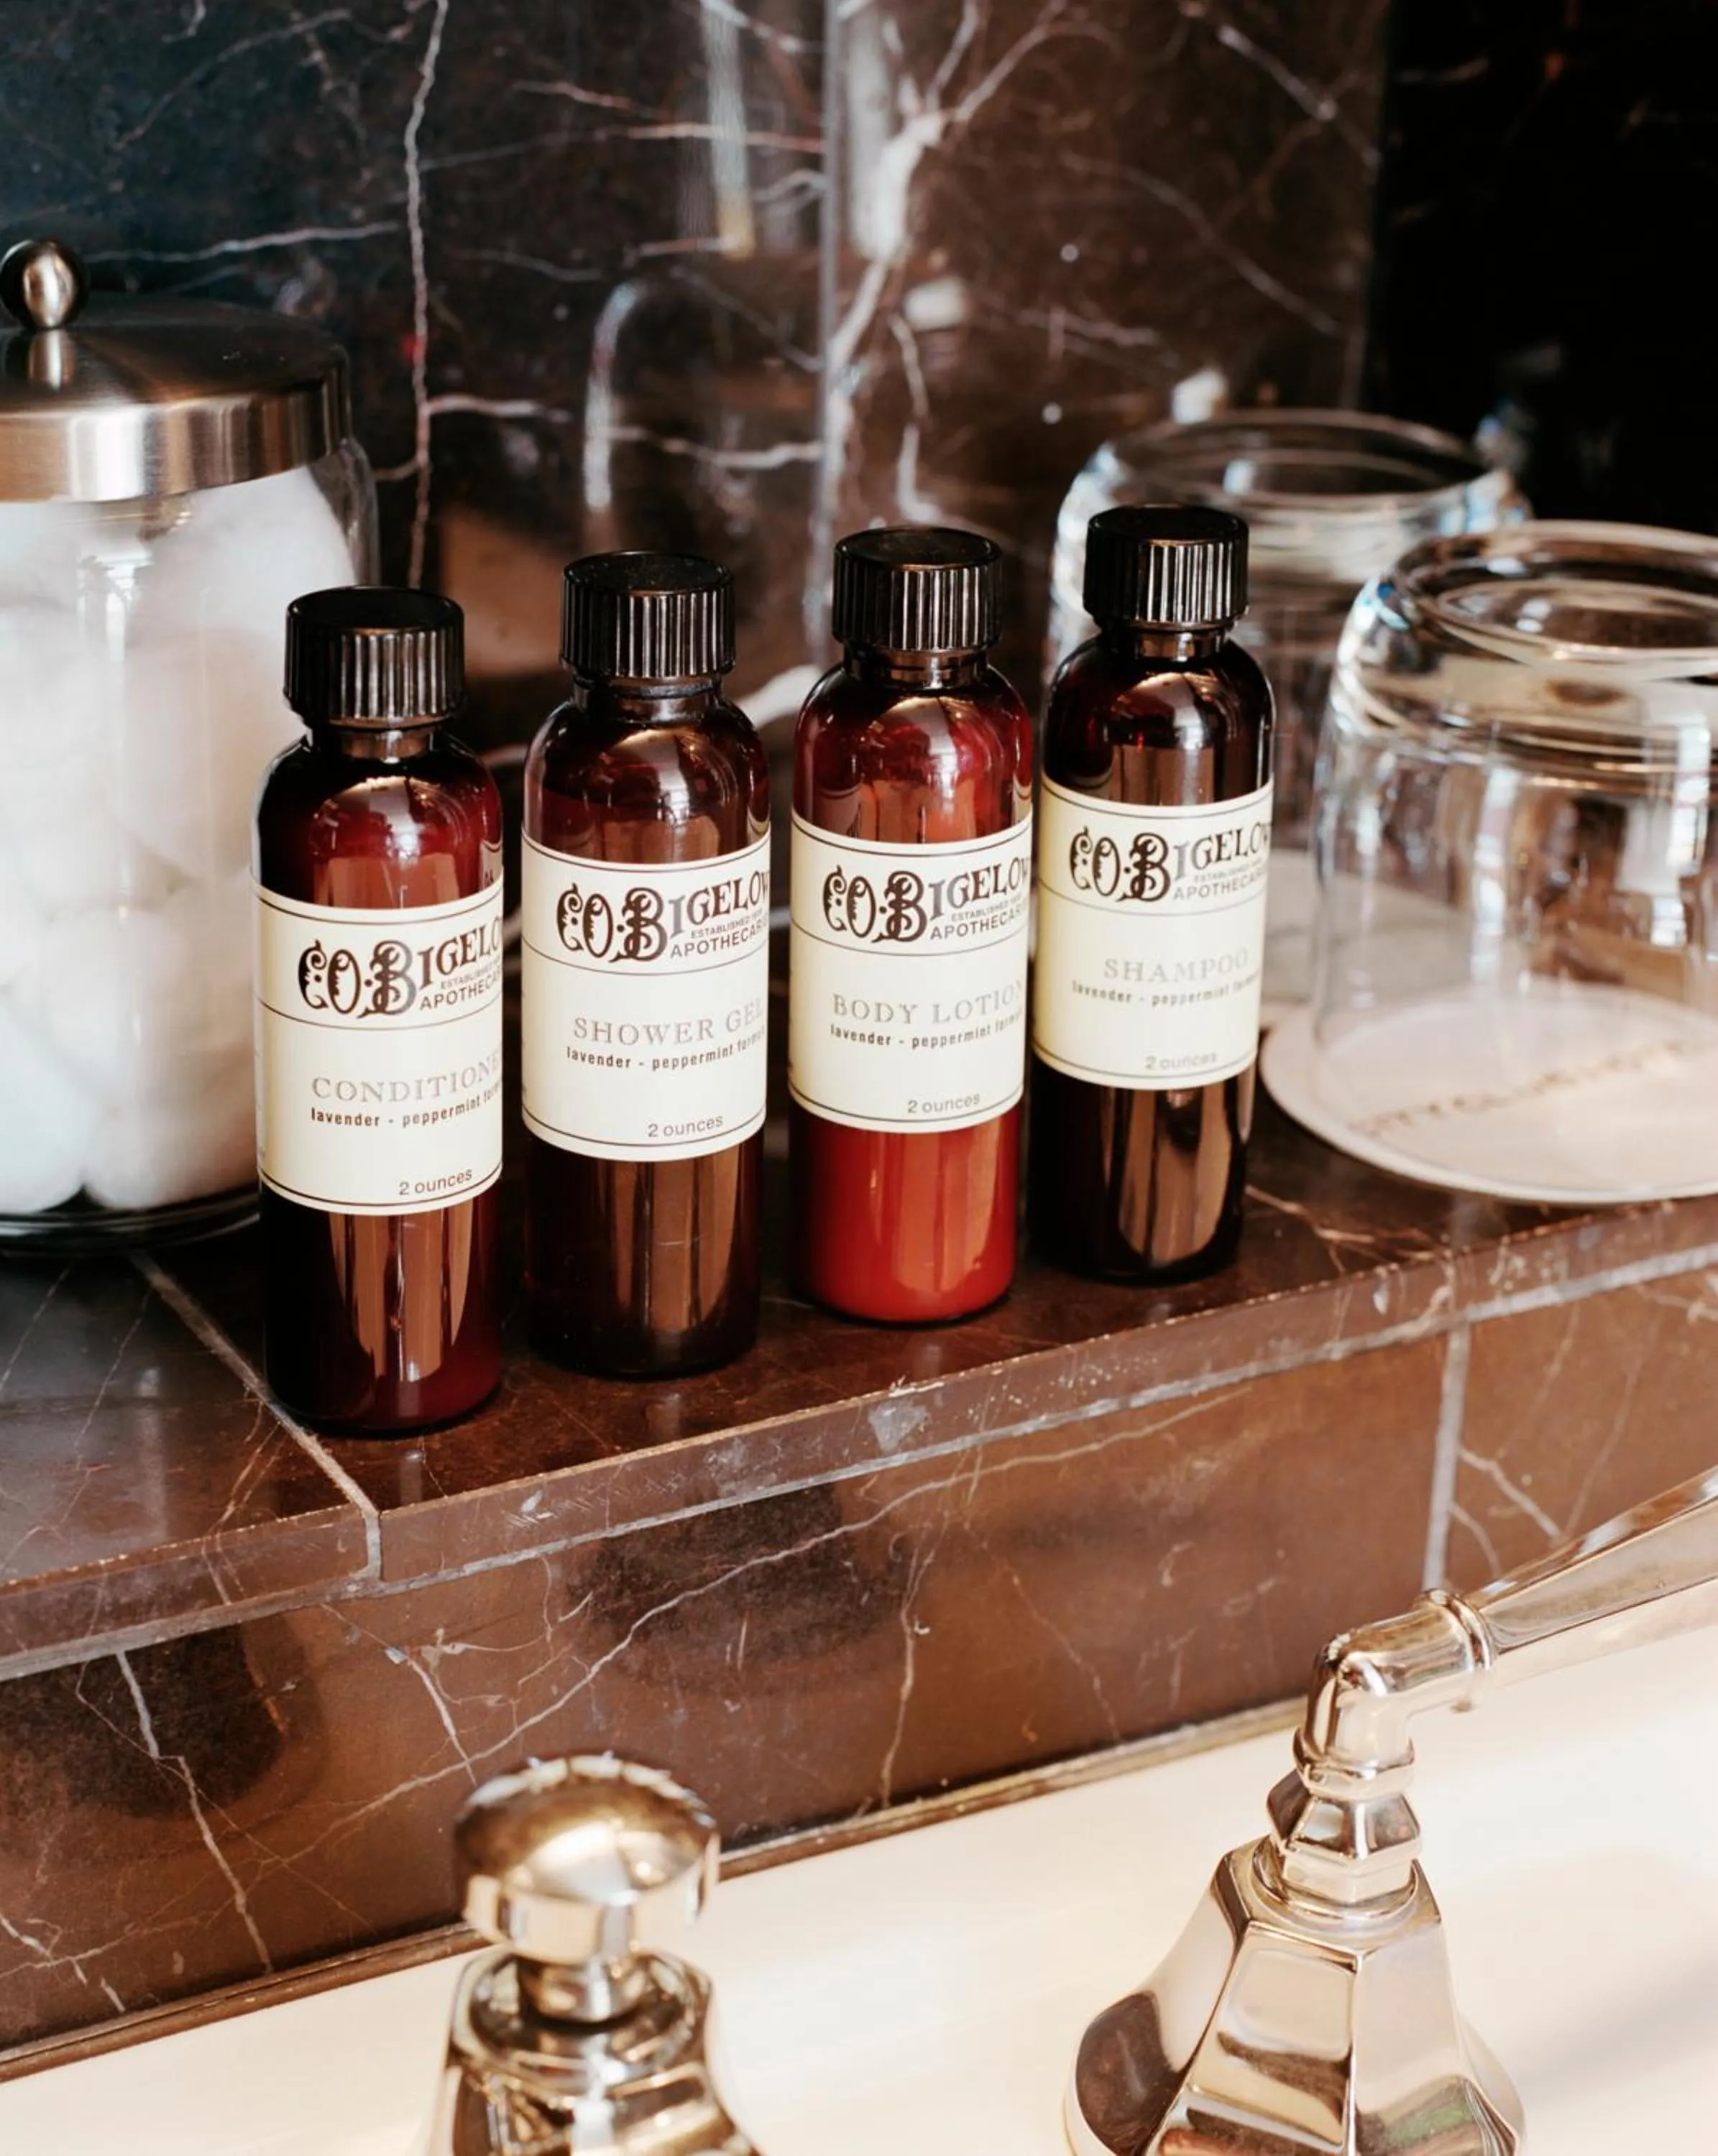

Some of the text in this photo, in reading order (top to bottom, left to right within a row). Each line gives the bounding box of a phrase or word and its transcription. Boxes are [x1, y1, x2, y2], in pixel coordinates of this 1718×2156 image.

[357, 916, 501, 1019] BIGELO
[1104, 947, 1248, 983] SHAMPOO
[1072, 980, 1131, 1004] lavender
[573, 998, 763, 1046] SHOWER GEL
[832, 994, 919, 1025] BODY
[830, 1023, 891, 1046] lavender
[911, 1024, 991, 1049] peppermint
[566, 1046, 631, 1069] lavender
[652, 1044, 732, 1071] peppermint
[1145, 1051, 1218, 1071] 2 ounces
[311, 1048, 500, 1102] CONDITIONE
[311, 1107, 380, 1128] lavender
[403, 1095, 479, 1128] peppermint
[907, 1092, 980, 1113] 2 ounces
[648, 1114, 723, 1138] 2 ounces
[398, 1169, 472, 1196] 2 ounces
